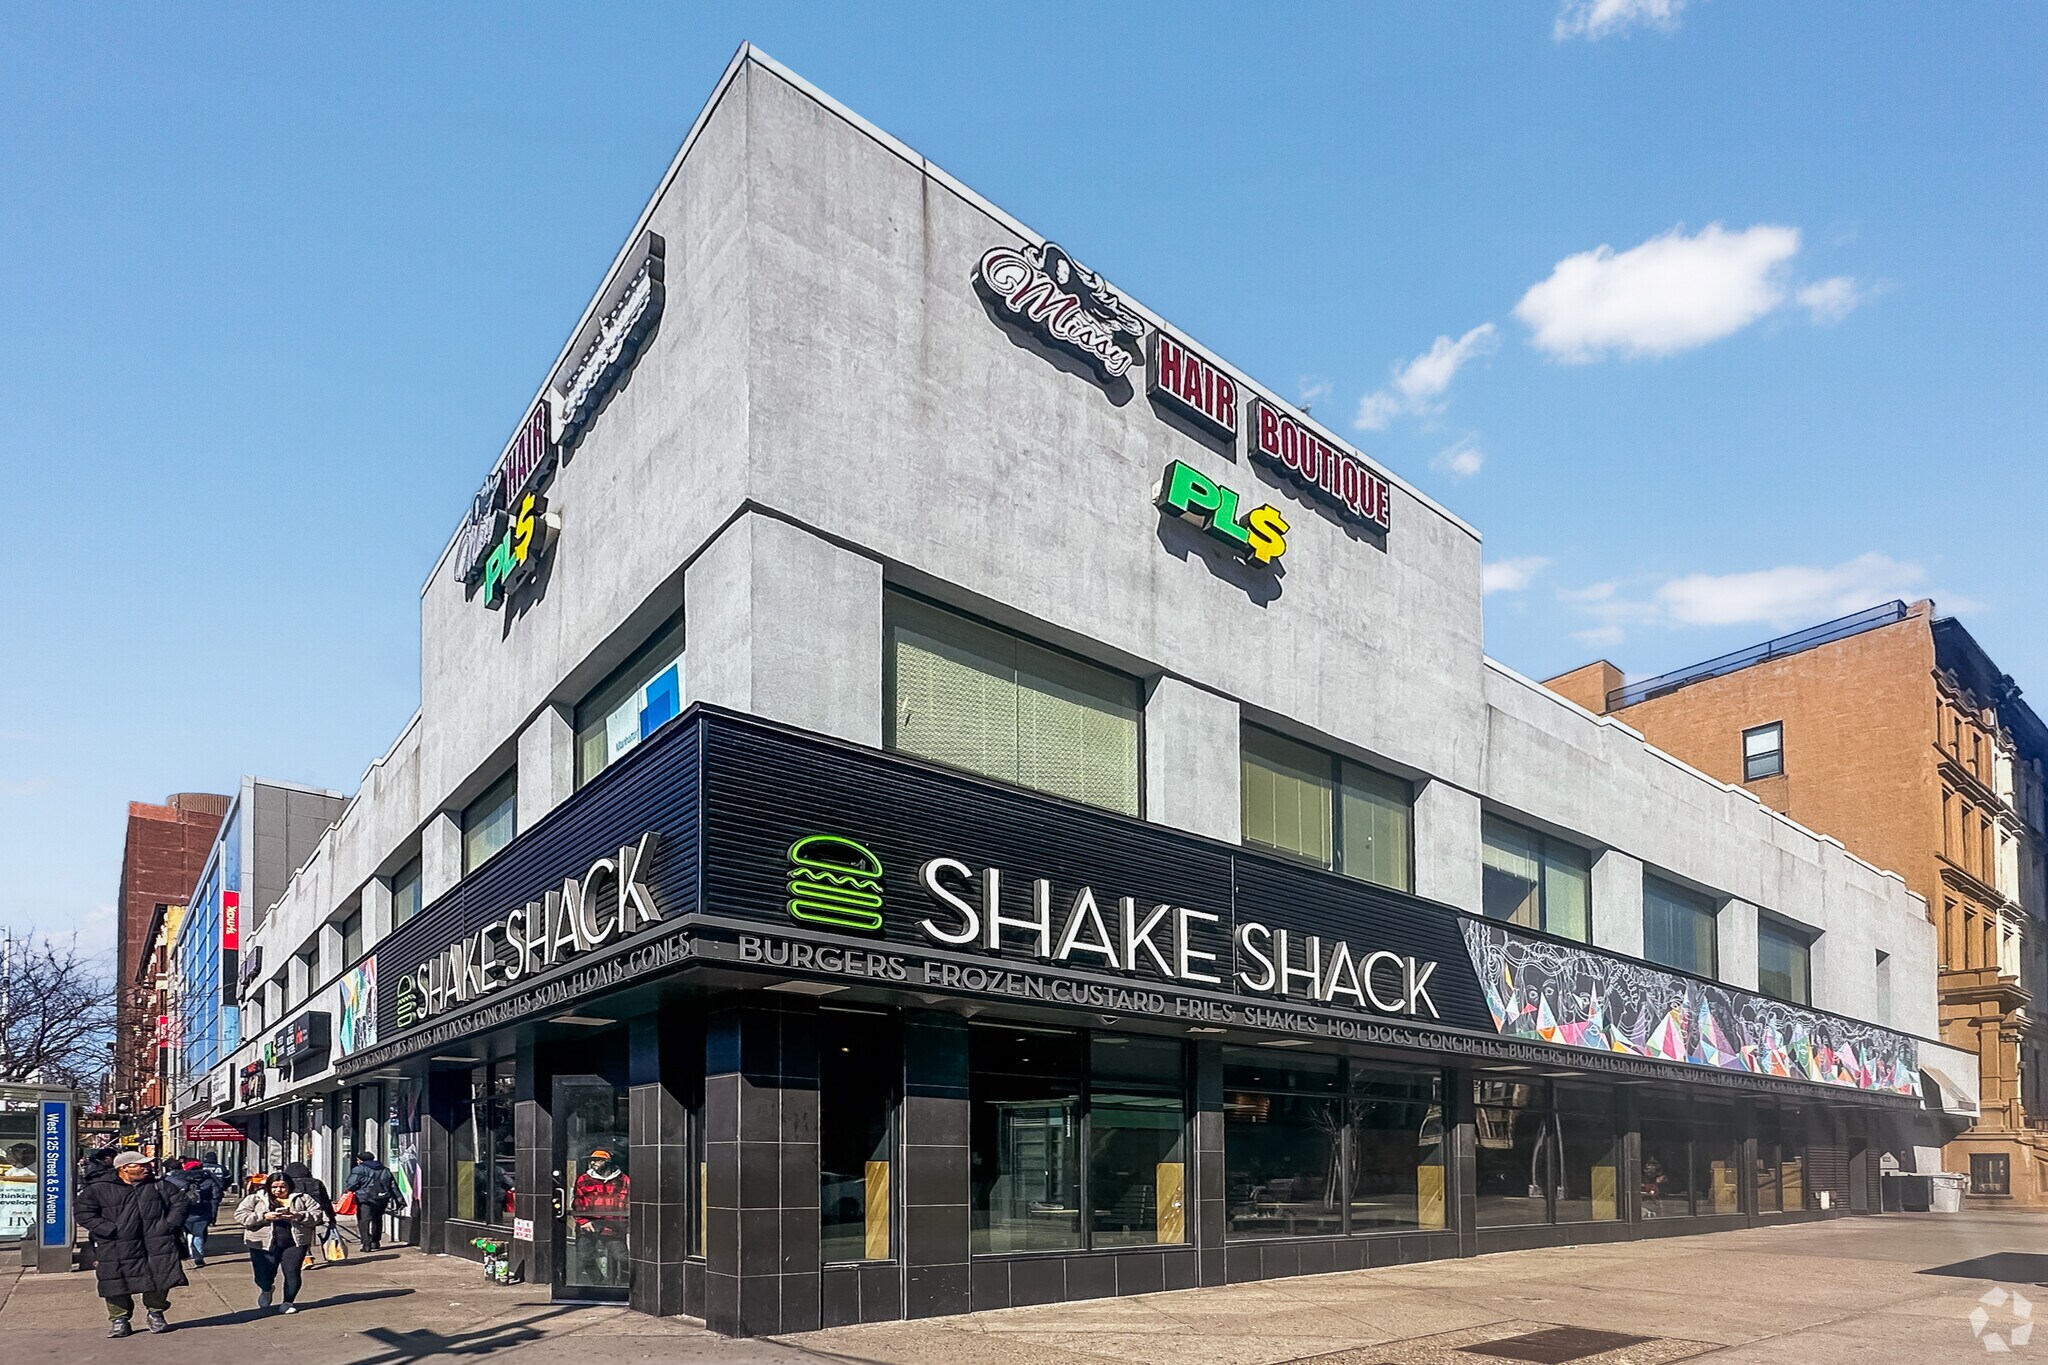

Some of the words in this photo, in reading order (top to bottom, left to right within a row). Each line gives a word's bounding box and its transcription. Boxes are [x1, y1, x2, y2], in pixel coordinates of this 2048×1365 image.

[981, 247, 1134, 377] Missy
[1158, 337, 1237, 433] HAIR
[1259, 401, 1389, 527] BOUTIQUE
[1167, 459, 1290, 565] PL$
[417, 921, 504, 1019] SHAKE
[504, 831, 663, 981] SHACK
[920, 857, 1222, 984] SHAKE
[1238, 921, 1441, 1019] SHACK
[474, 993, 531, 1030] CONCRETES
[535, 979, 568, 1008] SODA
[572, 957, 623, 995] FLOATS
[629, 931, 691, 973] CONES
[739, 936, 907, 981] BURGERS
[924, 961, 1044, 999] FROZEN
[1051, 979, 1166, 1014] CUSTARD
[1176, 997, 1236, 1023] FRIES
[1244, 1007, 1318, 1033] SHAKES
[1367, 1025, 1412, 1045] DOGS
[1418, 1032, 1503, 1056] CONCRETES
[1509, 1043, 1563, 1064] BURGERS
[47, 1113, 60, 1134] West
[47, 1136, 59, 1151] 125
[47, 1152, 60, 1177] Street
[46, 1193, 60, 1224] Avenue
